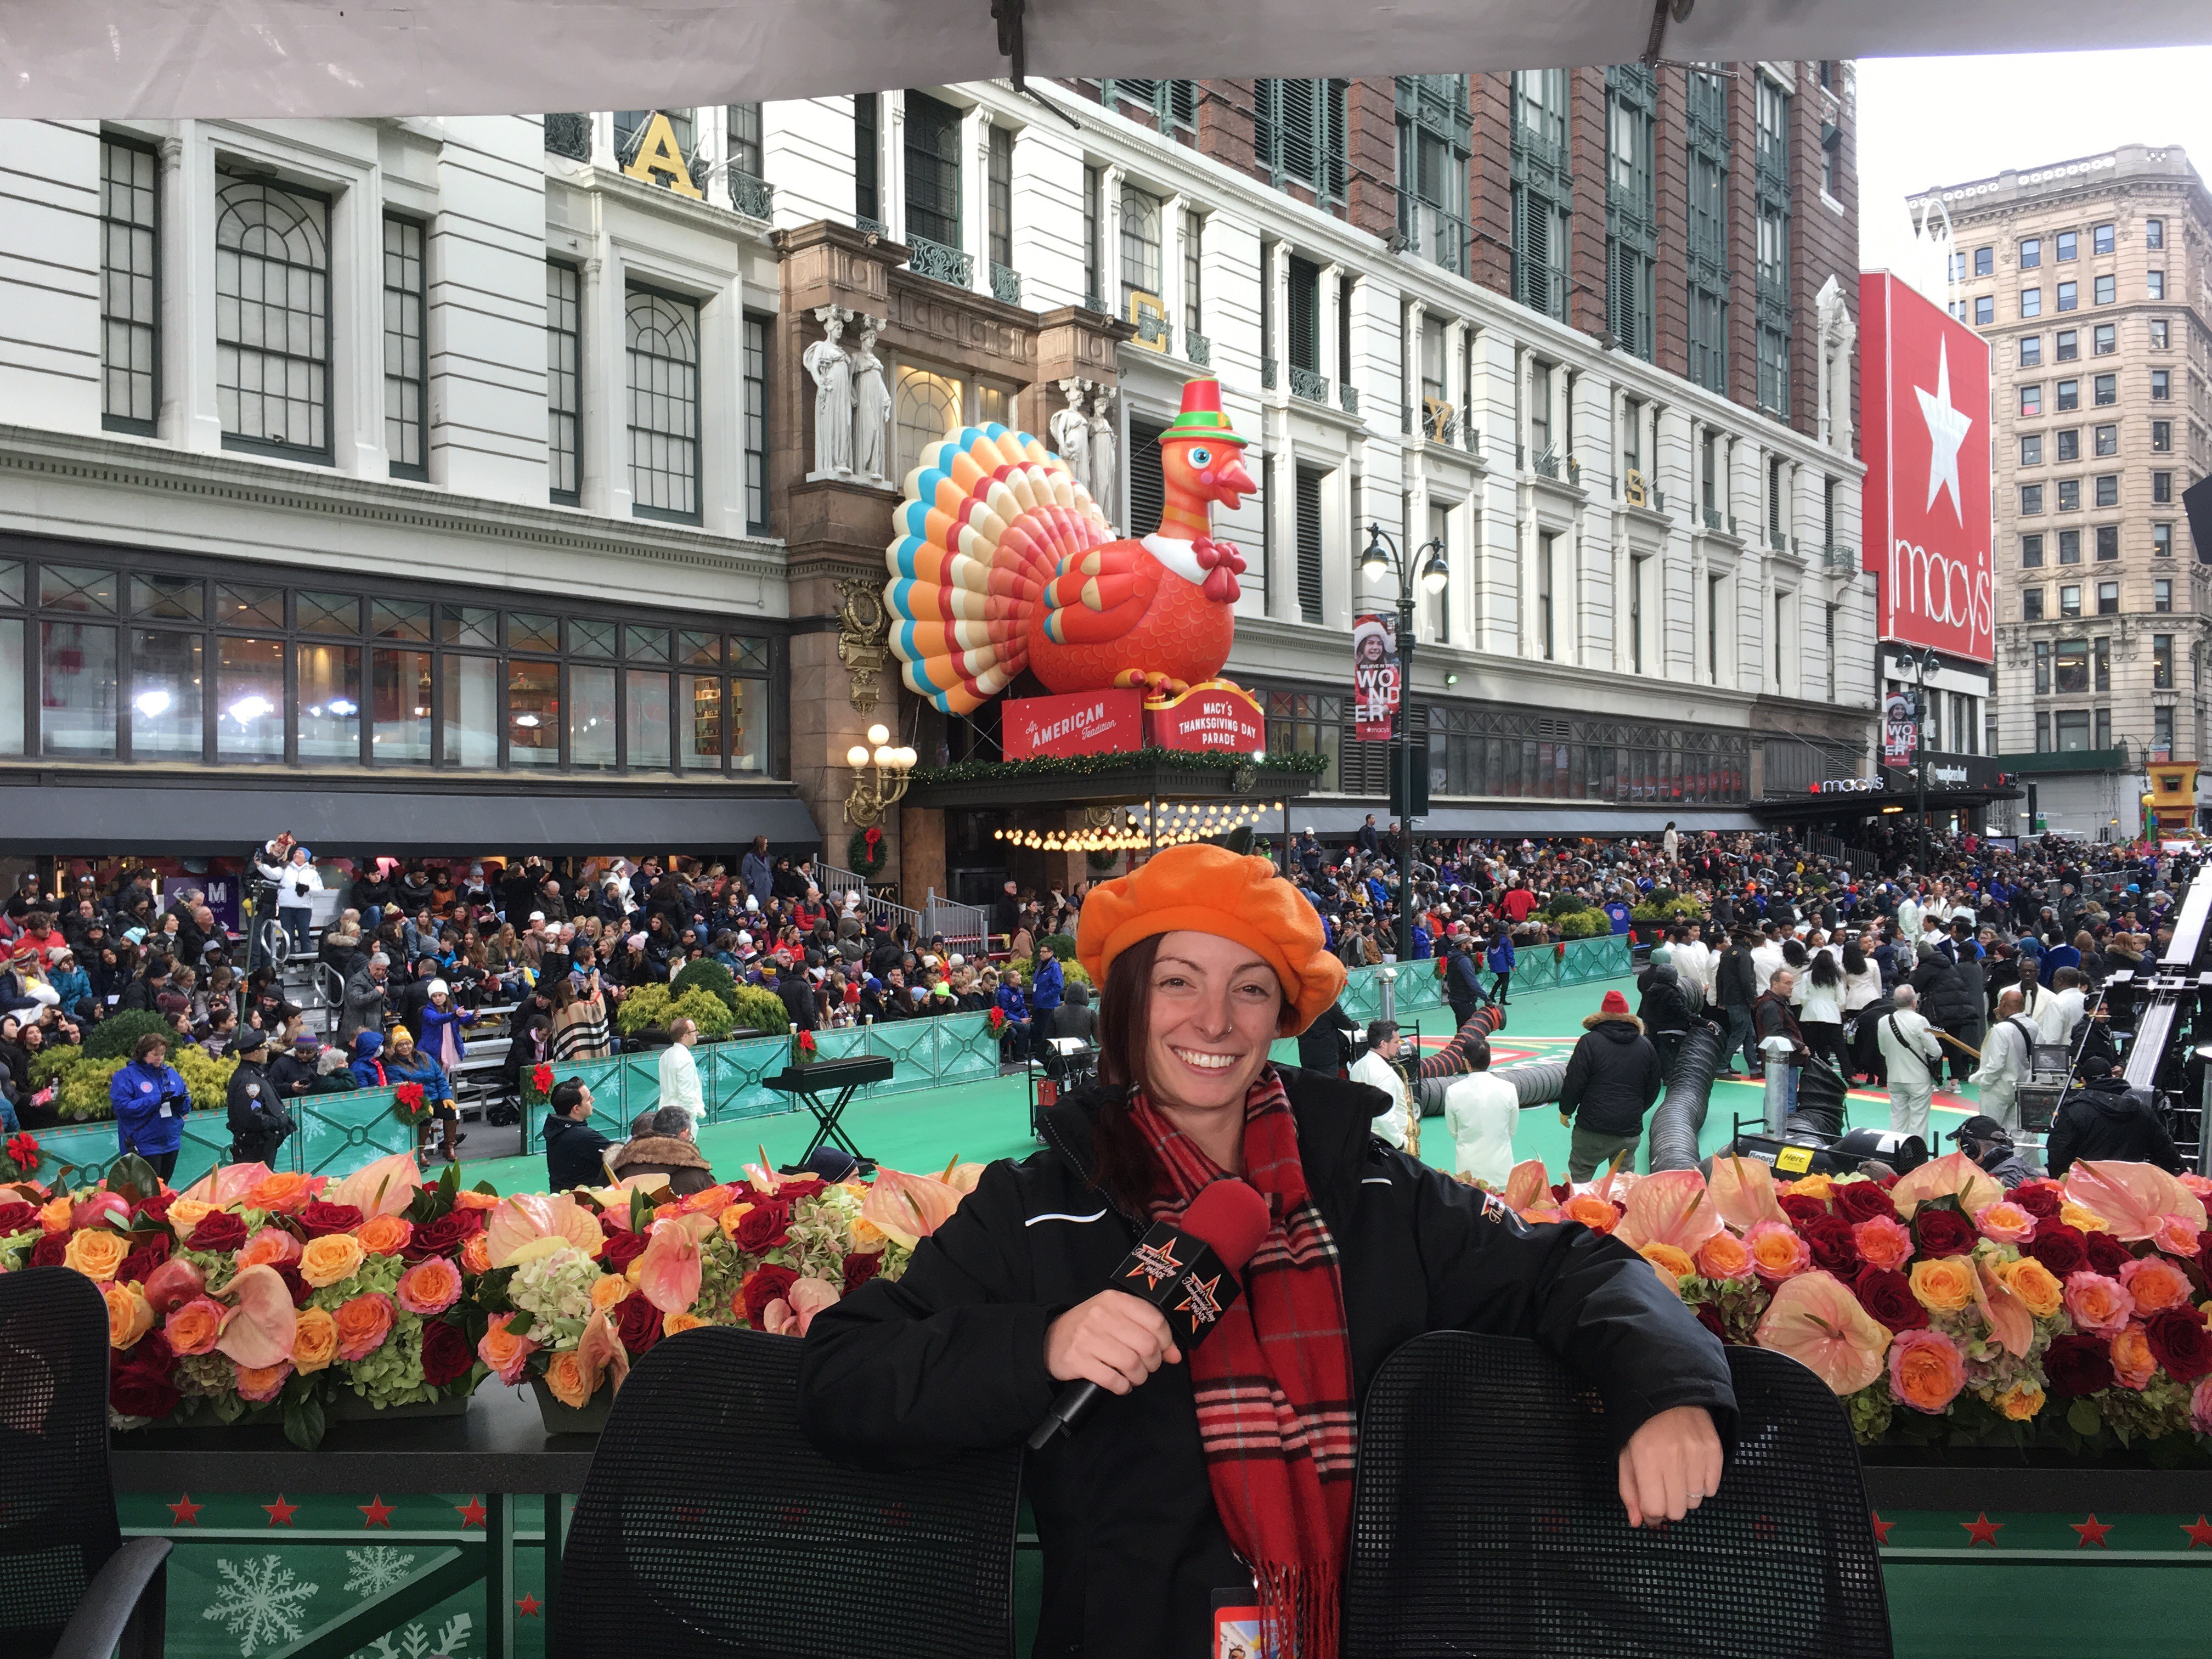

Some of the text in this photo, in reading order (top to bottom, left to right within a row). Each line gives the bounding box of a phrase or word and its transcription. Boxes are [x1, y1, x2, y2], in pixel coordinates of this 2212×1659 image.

[1203, 701, 1233, 716] MACY'S
[1025, 720, 1039, 735] An
[1032, 702, 1104, 749] AMERICAN
[1081, 720, 1117, 740] Tradition
[1179, 717, 1256, 739] THANKSGIVING DAY
[1202, 732, 1235, 746] PARADE
[208, 882, 227, 903] M
[1784, 1154, 1805, 1163] Herc
[1144, 1265, 1166, 1280] PARADE
[1190, 1302, 1207, 1323] PARADE
